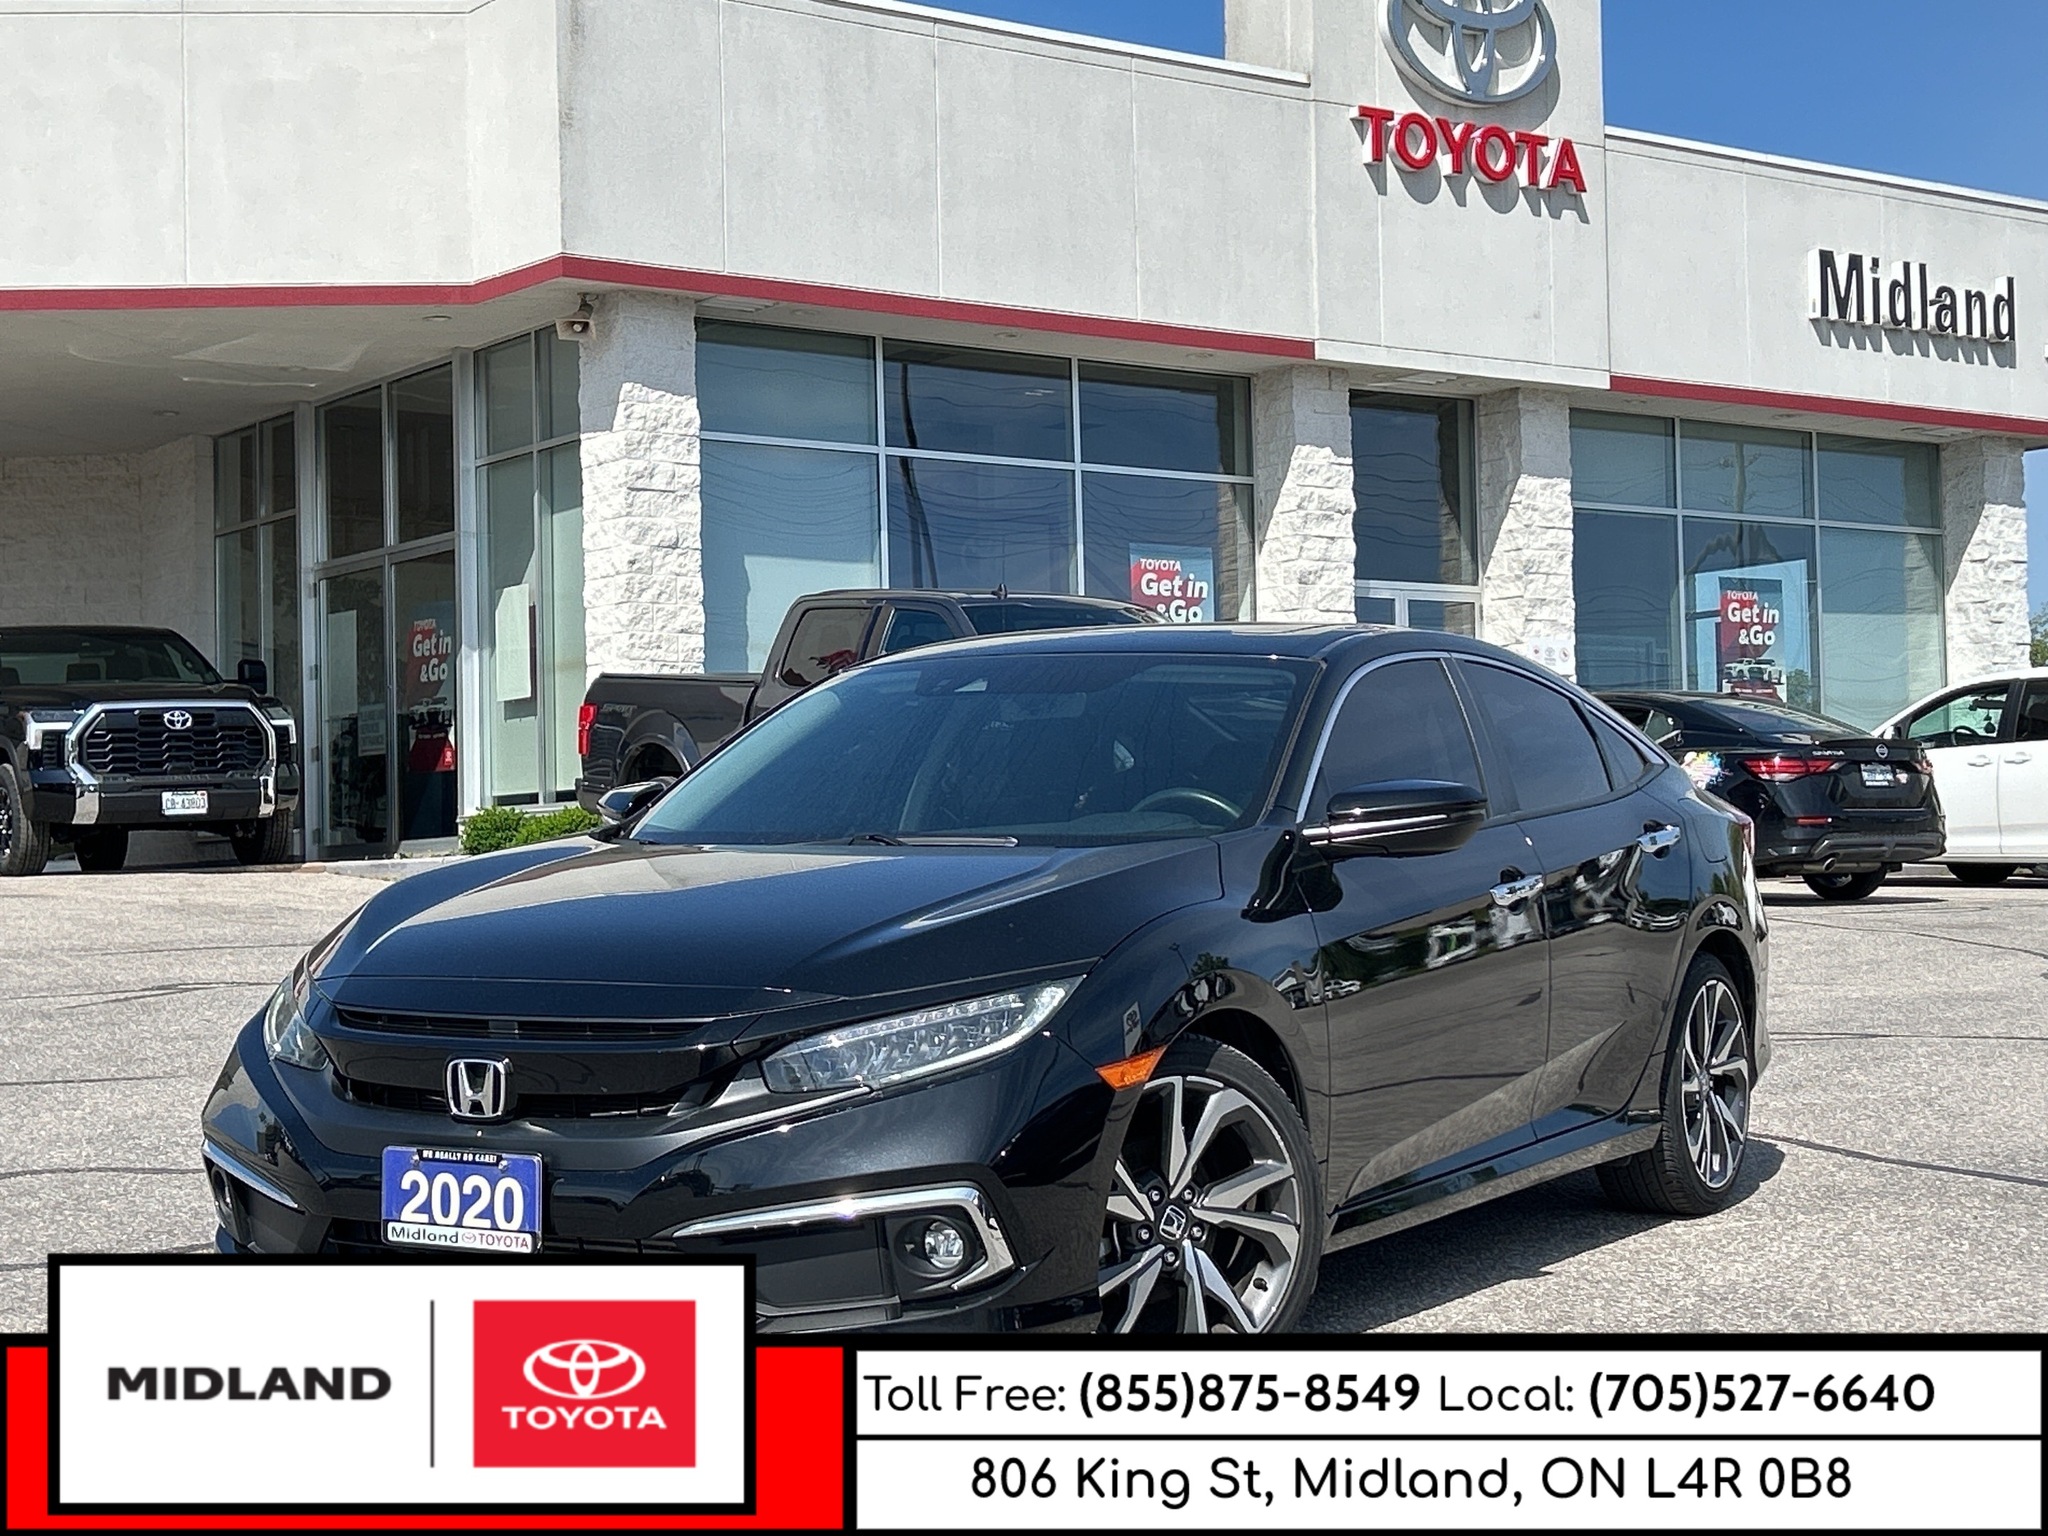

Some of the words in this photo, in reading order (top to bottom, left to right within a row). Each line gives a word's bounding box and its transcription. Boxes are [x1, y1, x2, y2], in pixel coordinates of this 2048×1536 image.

[1356, 104, 1588, 194] TOYOTA
[1814, 249, 2016, 342] Midland
[1140, 558, 1181, 572] TOYOTA
[1141, 572, 1182, 598] Get
[1186, 573, 1209, 598] in
[1726, 590, 1758, 601] TOYOTA
[413, 618, 437, 632] TOYOTA
[1727, 602, 1760, 623] Get
[1763, 602, 1780, 624] in
[413, 633, 438, 657] Get
[438, 630, 452, 655] in
[1738, 625, 1775, 646] &Go
[419, 658, 449, 682] &Go
[400, 1169, 525, 1232] 2020
[391, 1226, 459, 1244] Midland
[479, 1233, 530, 1250] TOYOTA
